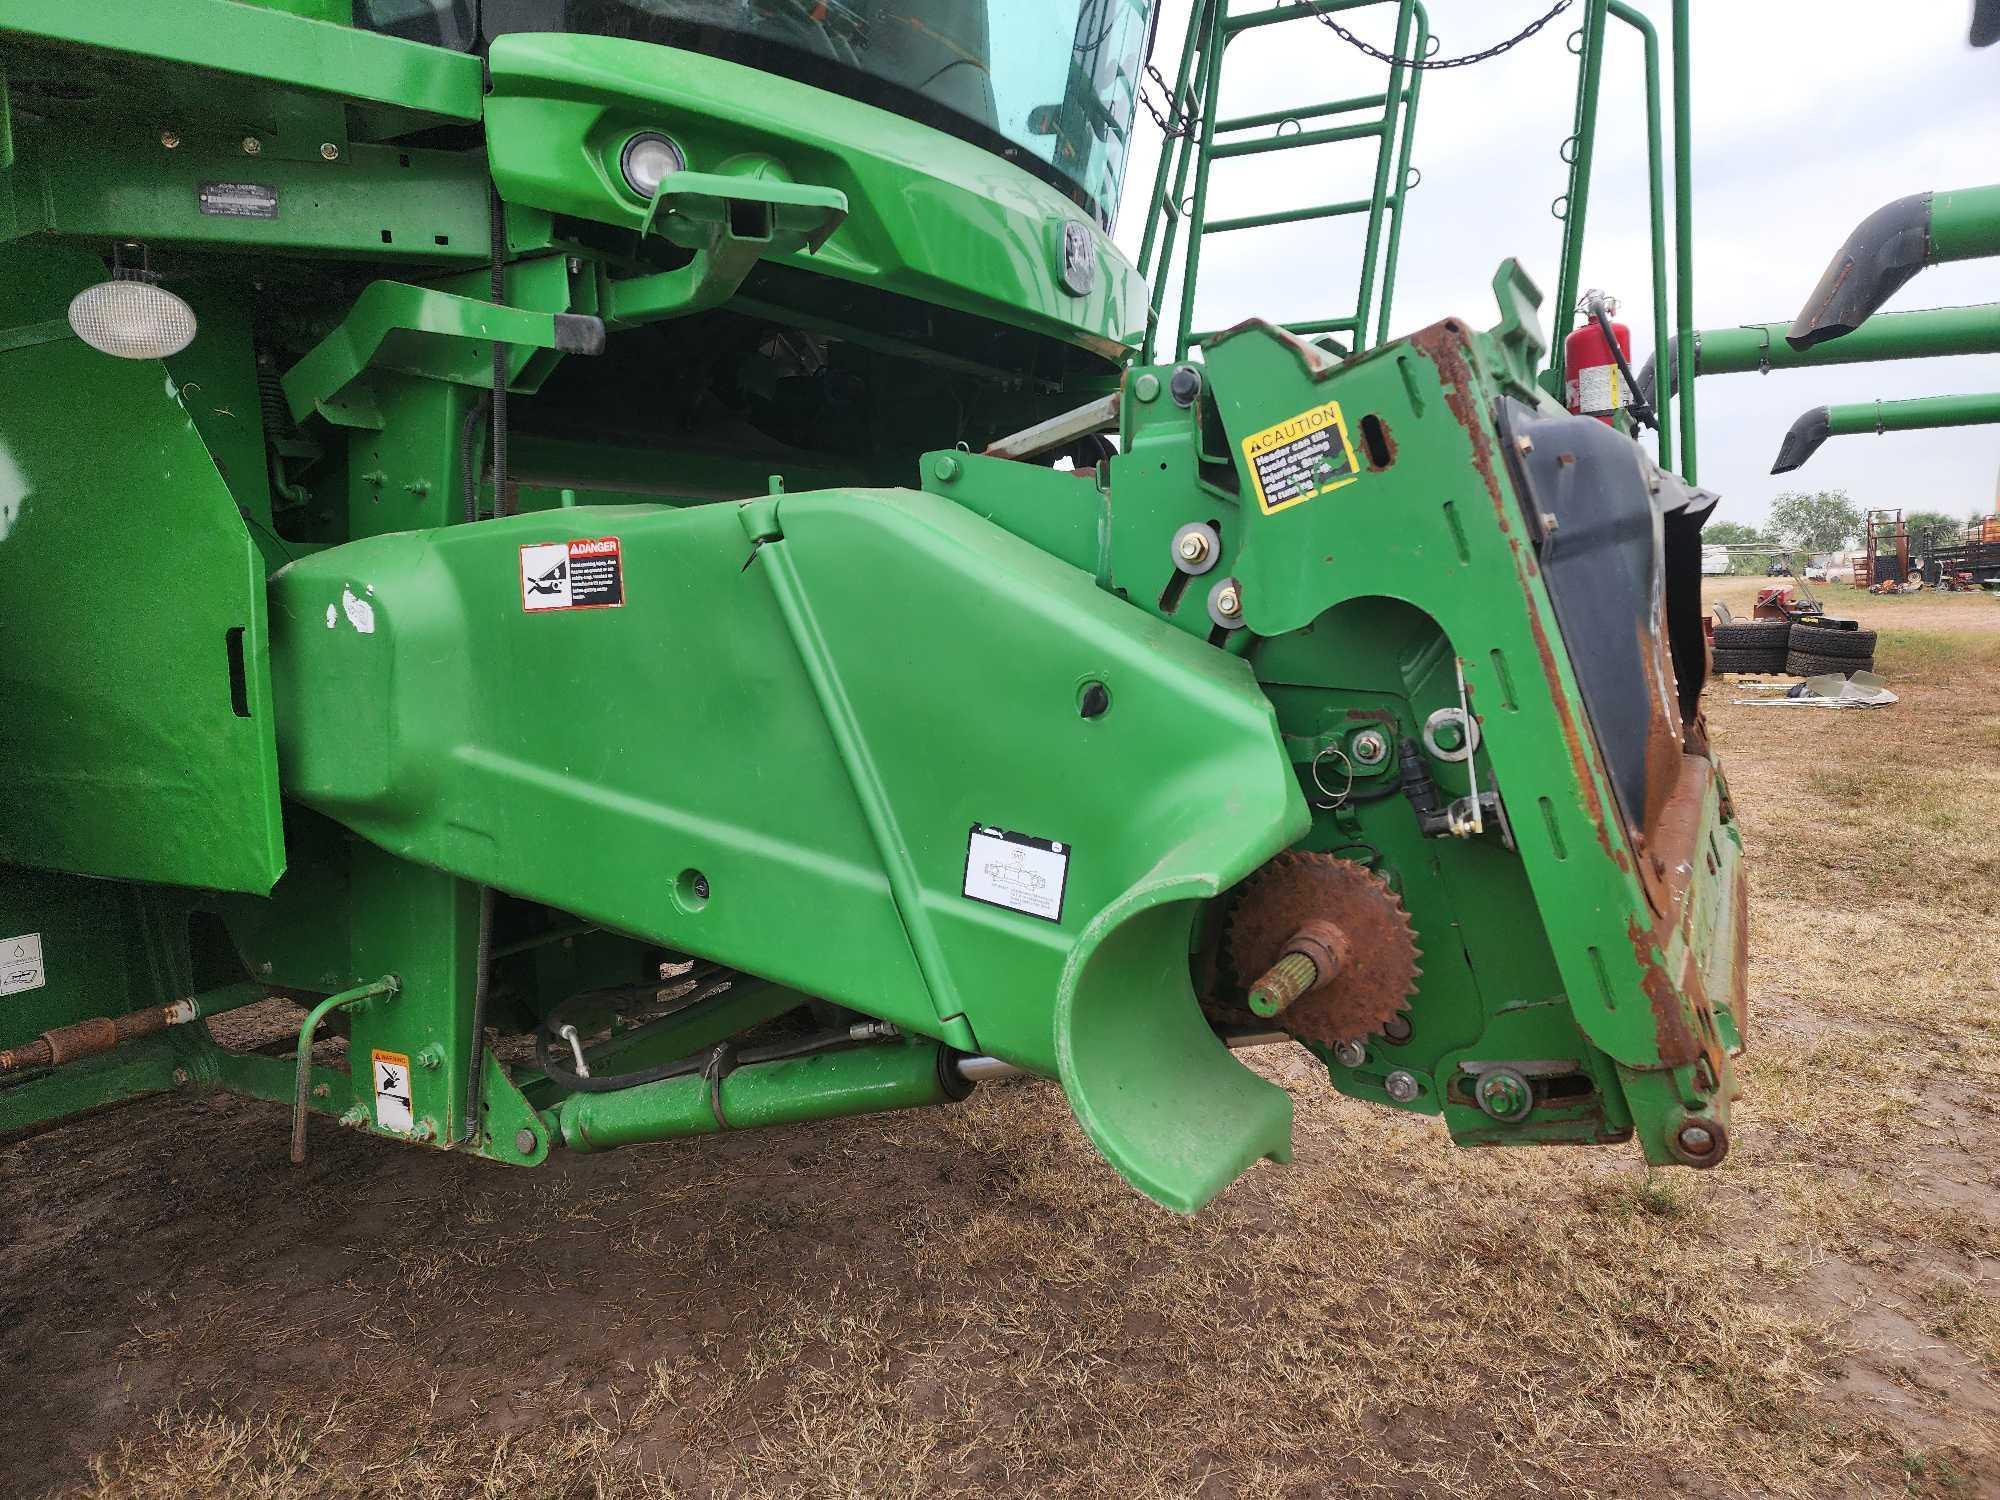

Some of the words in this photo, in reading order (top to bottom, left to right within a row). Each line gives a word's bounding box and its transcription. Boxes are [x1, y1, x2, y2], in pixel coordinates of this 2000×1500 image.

[1262, 407, 1335, 447] CAUTION
[1291, 438, 1311, 451] can
[1260, 457, 1288, 476] Avoid
[1287, 441, 1331, 464] crushing
[579, 541, 617, 554] DANGER
